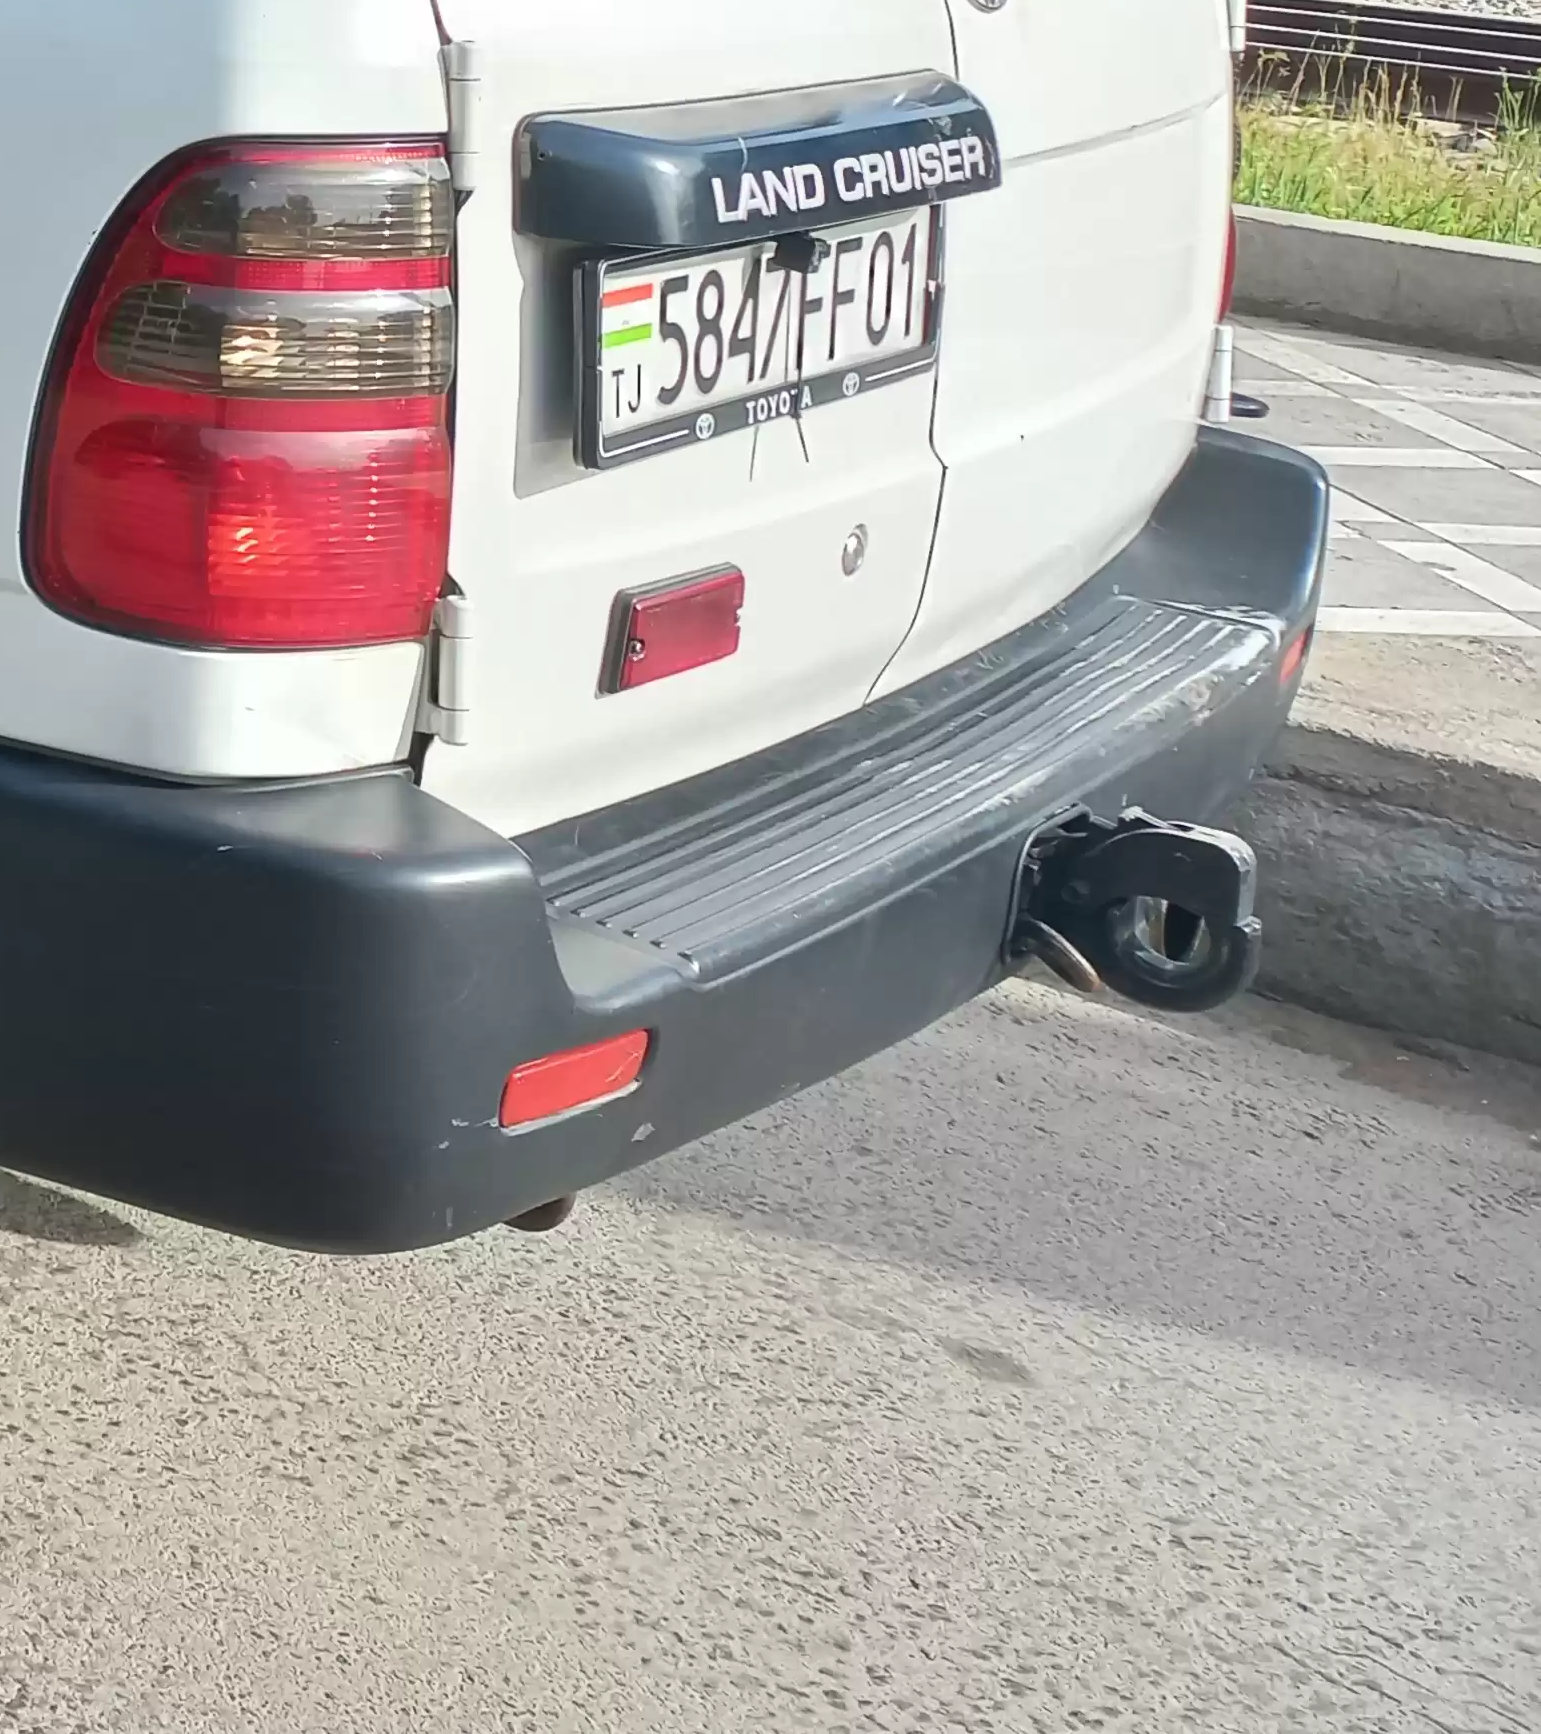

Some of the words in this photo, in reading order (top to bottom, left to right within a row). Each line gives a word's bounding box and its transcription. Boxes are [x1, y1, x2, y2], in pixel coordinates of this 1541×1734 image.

[711, 163, 826, 224] LAND
[833, 135, 986, 203] CRUISER
[610, 363, 642, 419] TJ
